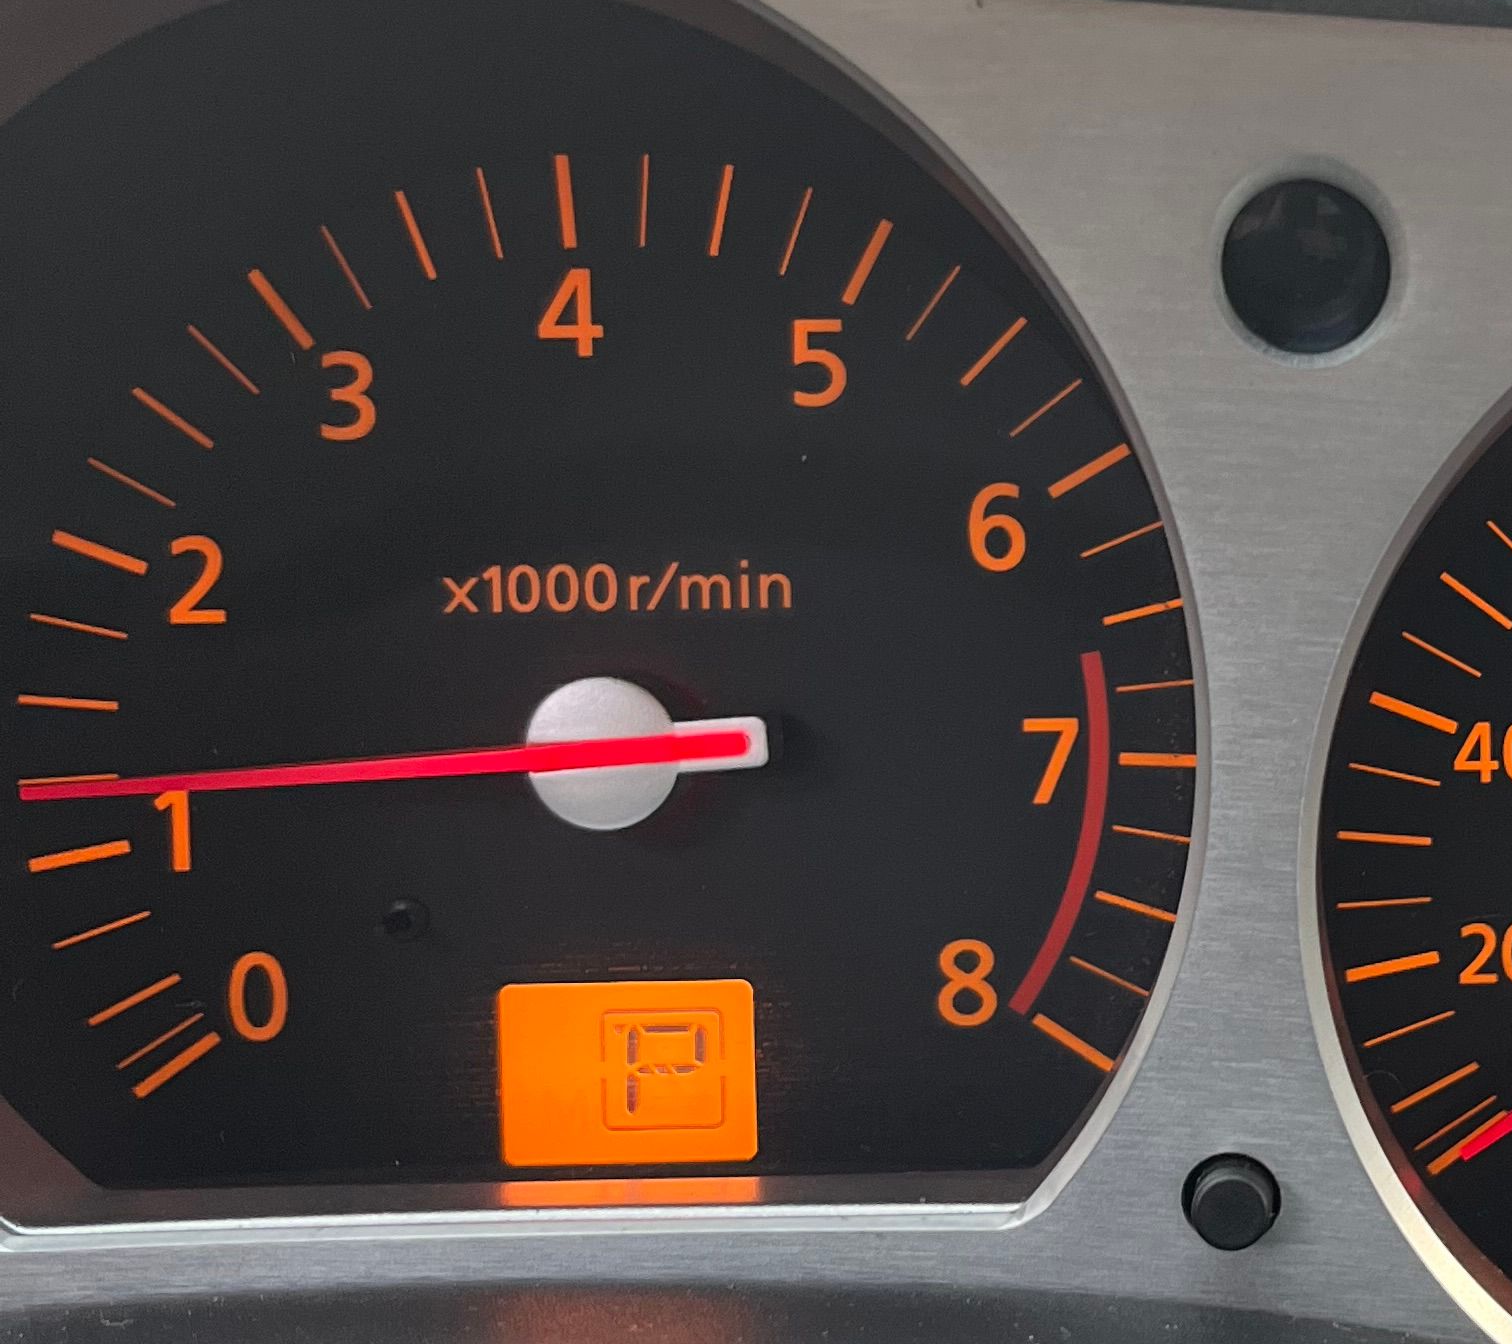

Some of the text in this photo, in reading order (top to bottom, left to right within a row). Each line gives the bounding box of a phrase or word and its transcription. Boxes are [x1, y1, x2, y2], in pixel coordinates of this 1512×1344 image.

[537, 268, 604, 358] 4
[320, 351, 376, 441] 3
[791, 319, 847, 408] 5
[967, 482, 1026, 573] 6
[168, 535, 227, 625] 2
[1022, 717, 1080, 805] 7
[153, 788, 192, 872] 1
[228, 951, 289, 1042] 0
[937, 939, 998, 1027] 8
[614, 1024, 707, 1116] P
